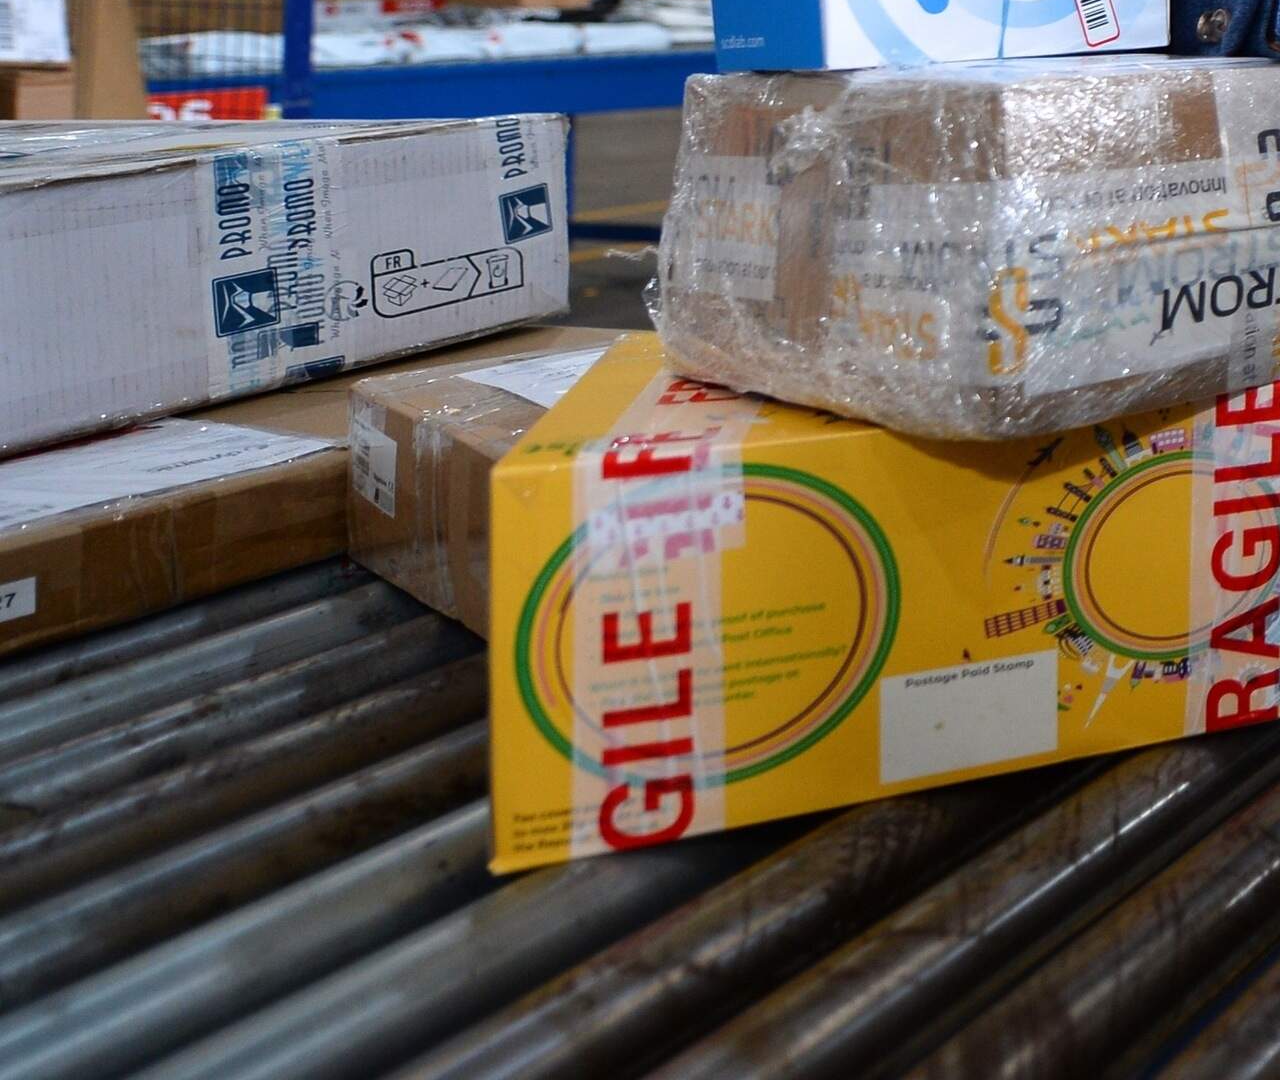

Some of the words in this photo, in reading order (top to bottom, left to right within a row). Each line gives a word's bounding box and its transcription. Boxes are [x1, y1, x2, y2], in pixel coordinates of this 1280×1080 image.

[217, 183, 253, 260] PROMO
[385, 255, 402, 270] FR
[904, 674, 959, 689] Postage
[961, 665, 990, 679] Paid
[993, 658, 1035, 673] Stamp
